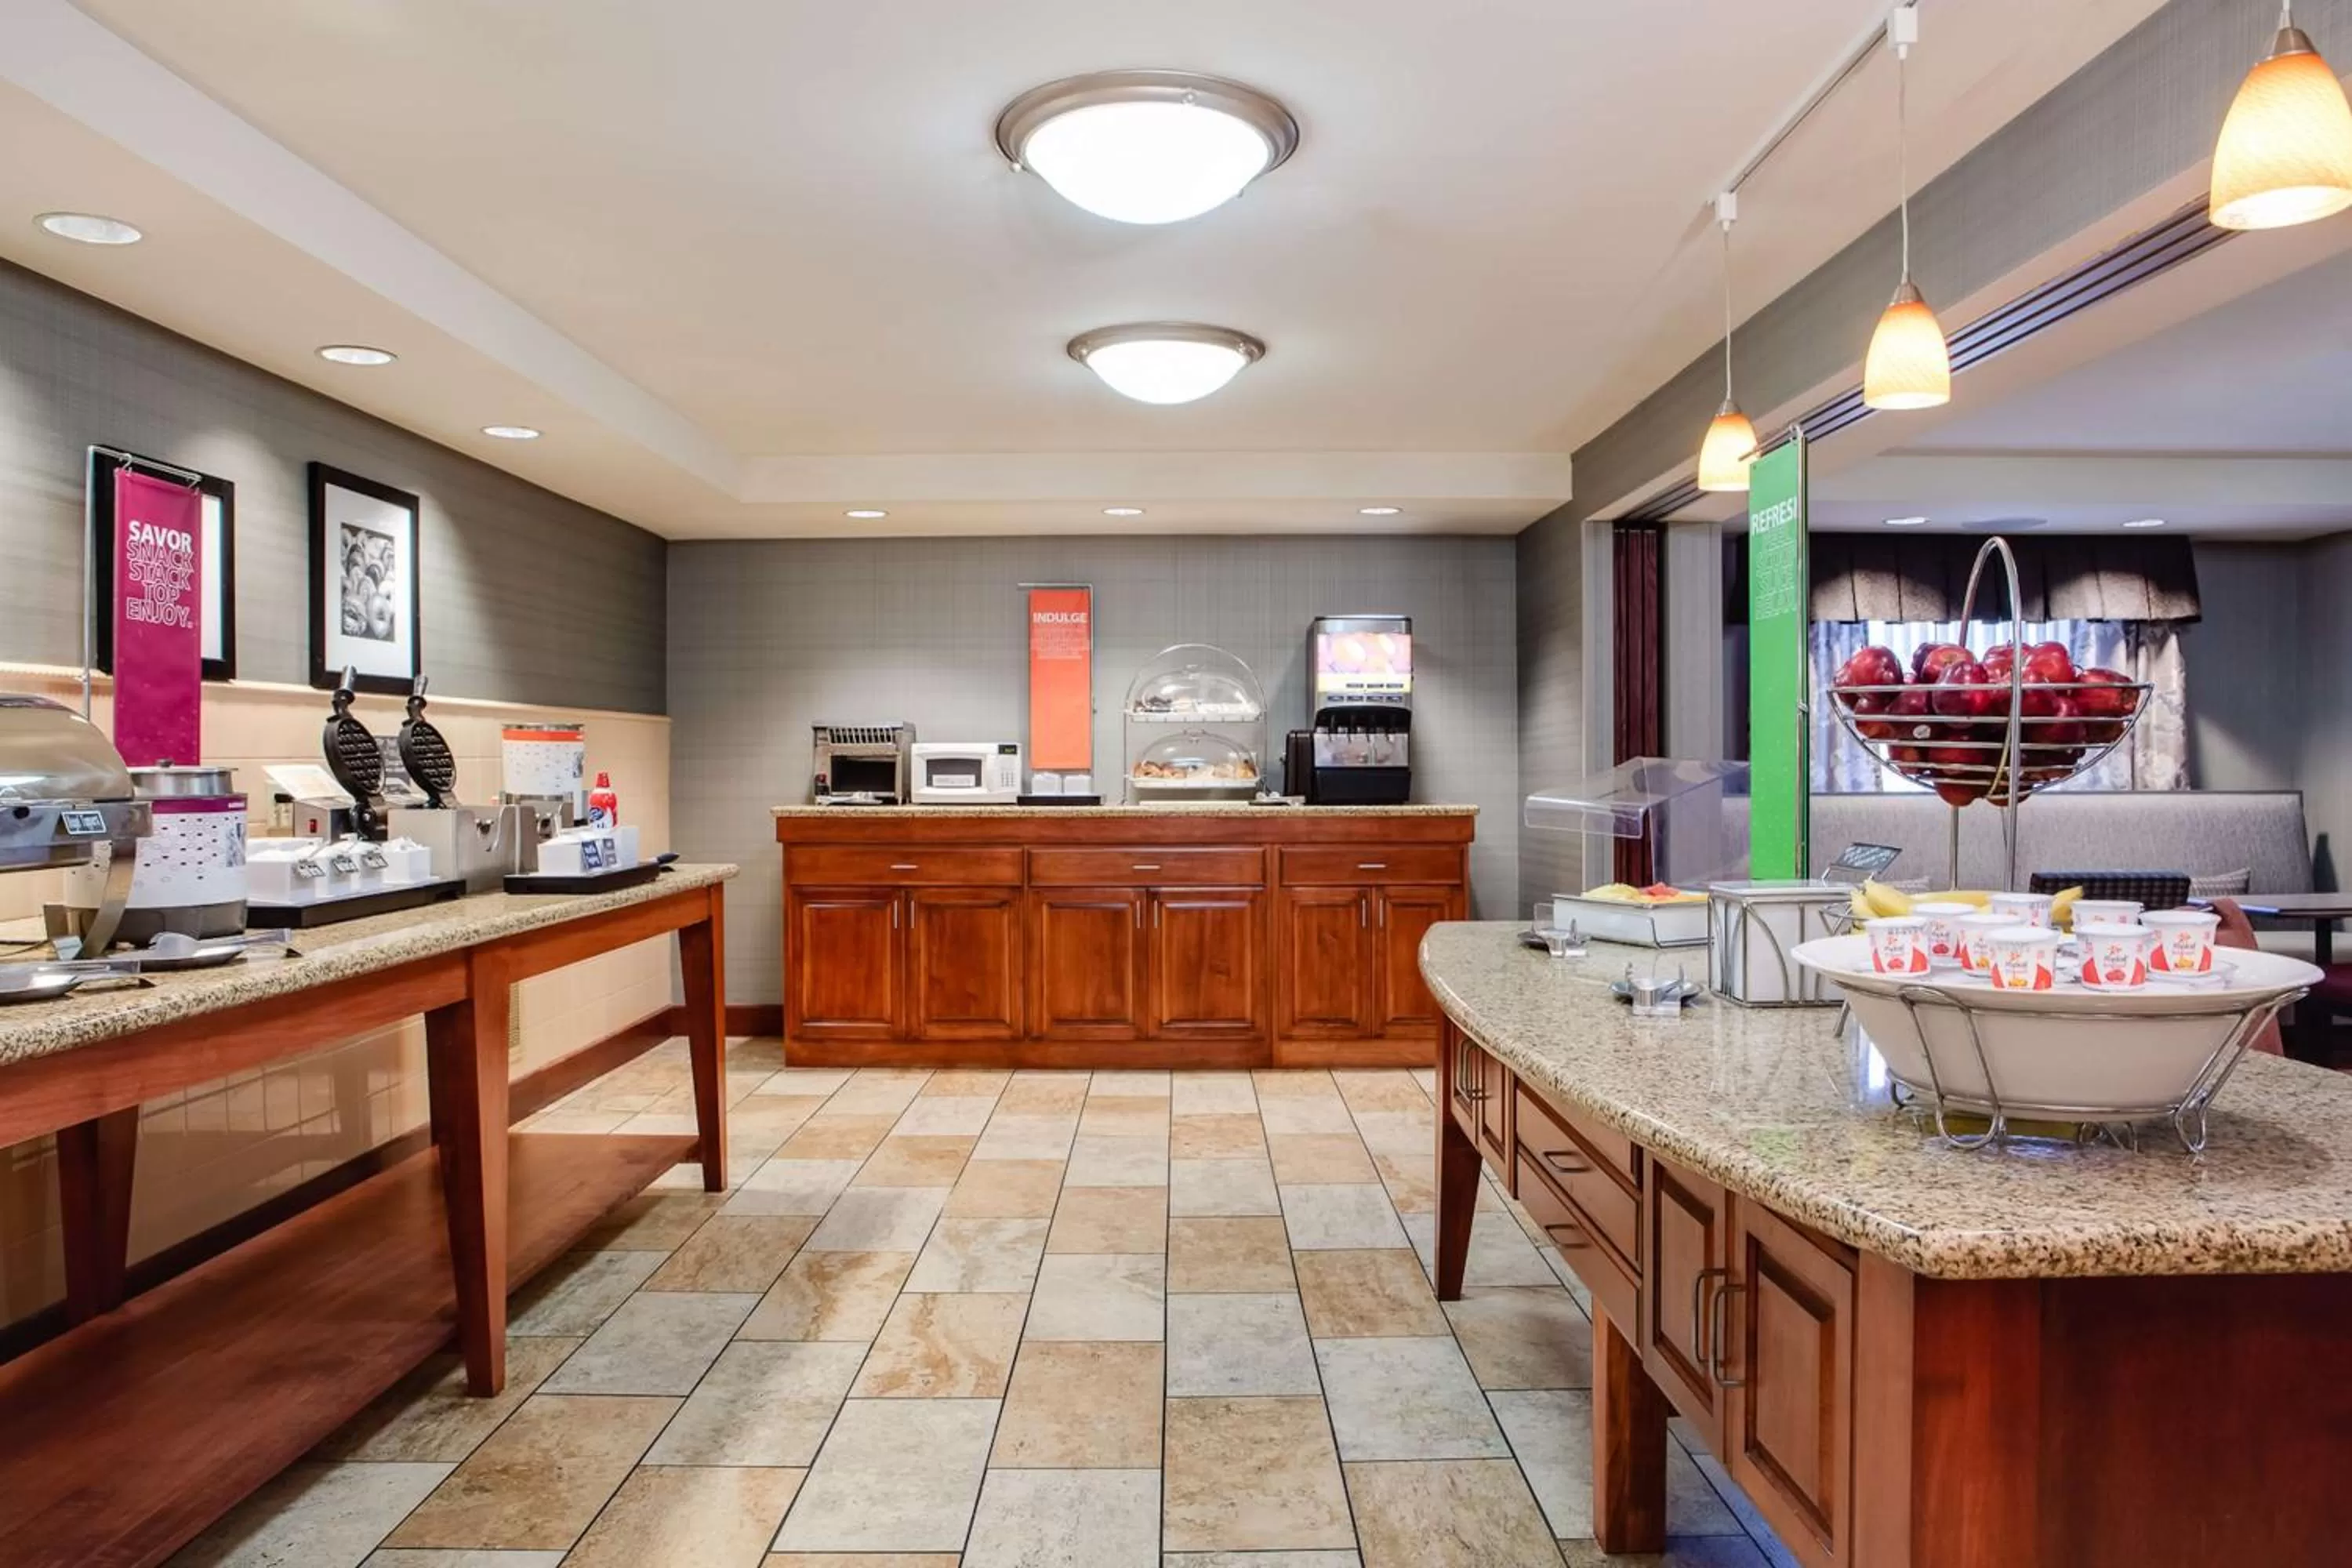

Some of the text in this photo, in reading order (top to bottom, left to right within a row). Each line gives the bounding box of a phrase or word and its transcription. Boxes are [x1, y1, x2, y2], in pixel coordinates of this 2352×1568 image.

[129, 520, 192, 554] SAVOR
[126, 539, 194, 570] SNACK
[129, 560, 193, 591] STACK
[141, 580, 180, 604] TOP
[126, 597, 194, 629] ENJOY.
[1033, 612, 1087, 624] INDULGE
